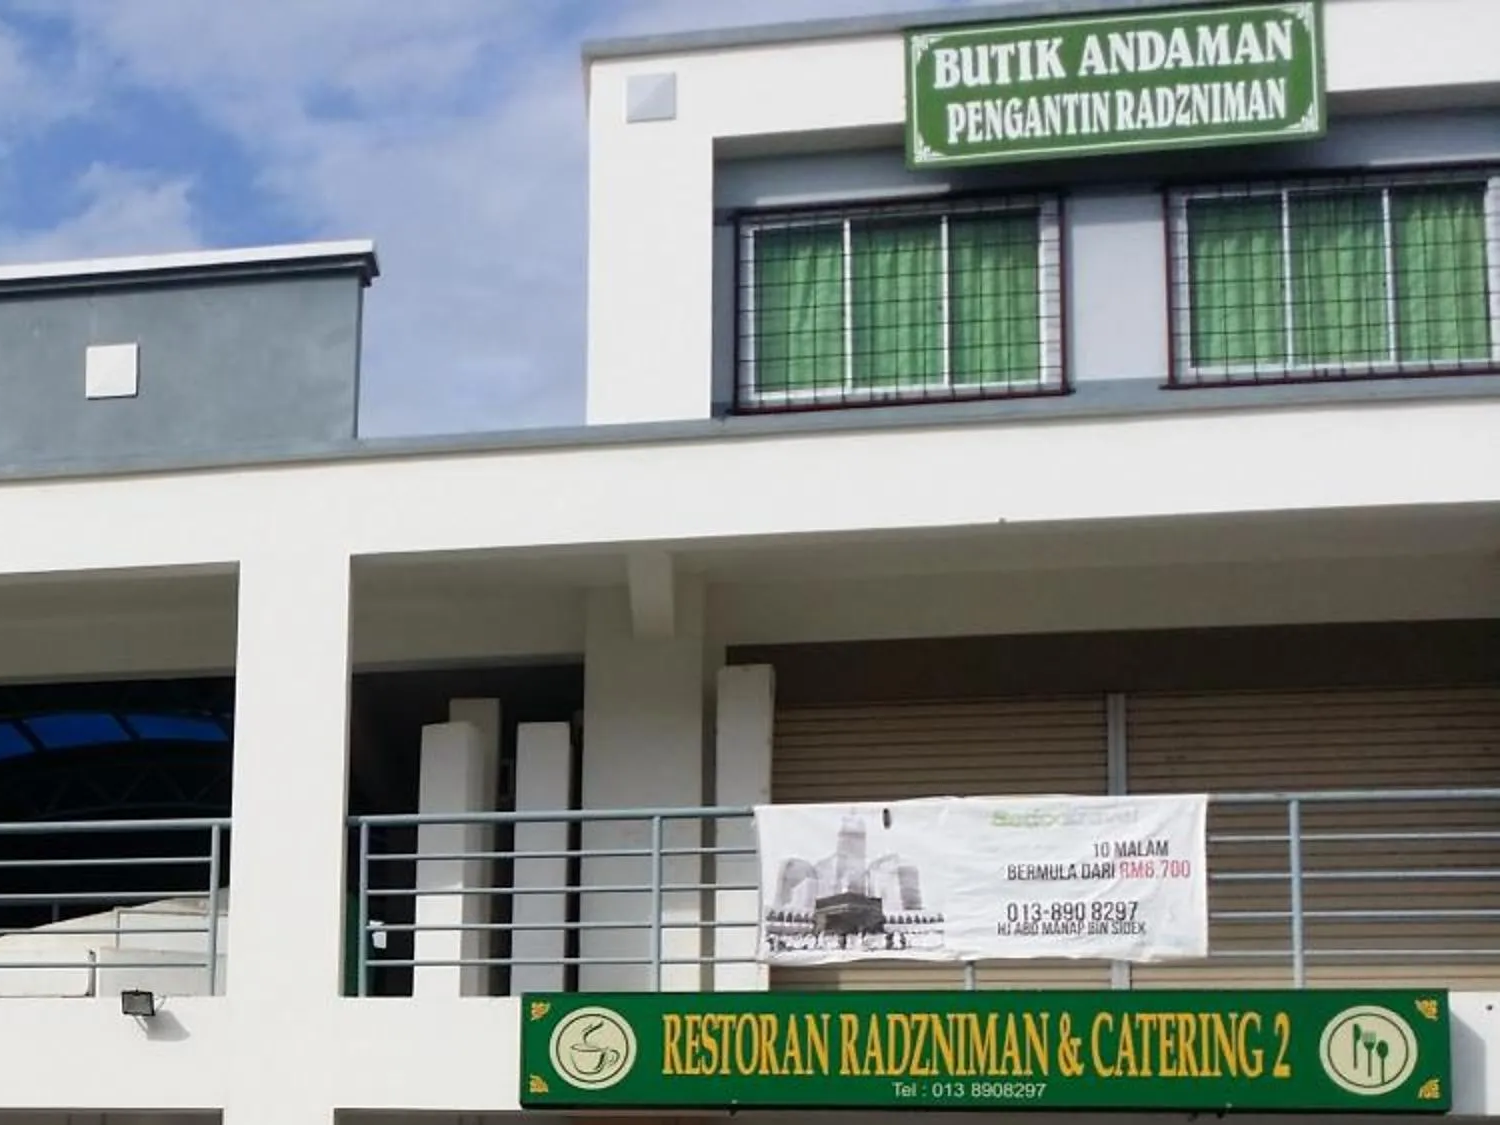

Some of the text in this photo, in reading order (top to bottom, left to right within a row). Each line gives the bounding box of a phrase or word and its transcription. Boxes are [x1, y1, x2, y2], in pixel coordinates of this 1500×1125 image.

[933, 19, 1294, 90] BUTIK ANDAMAN
[946, 77, 1288, 145] PENGANTIN RADZNIMAN
[1093, 839, 1169, 858] 10 MALAM
[1007, 863, 1077, 881] BERMULA
[1081, 862, 1115, 880] DARI
[1007, 901, 1139, 922] 013-890 8297
[1042, 921, 1084, 936] MANAP
[1088, 921, 1108, 936] BIN
[662, 1012, 1292, 1078] RESTORAN RADZNIMAN & CATERING 2
[892, 1082, 917, 1098] Tel
[932, 1082, 965, 1098] 013
[971, 1082, 1047, 1099] 8908297
